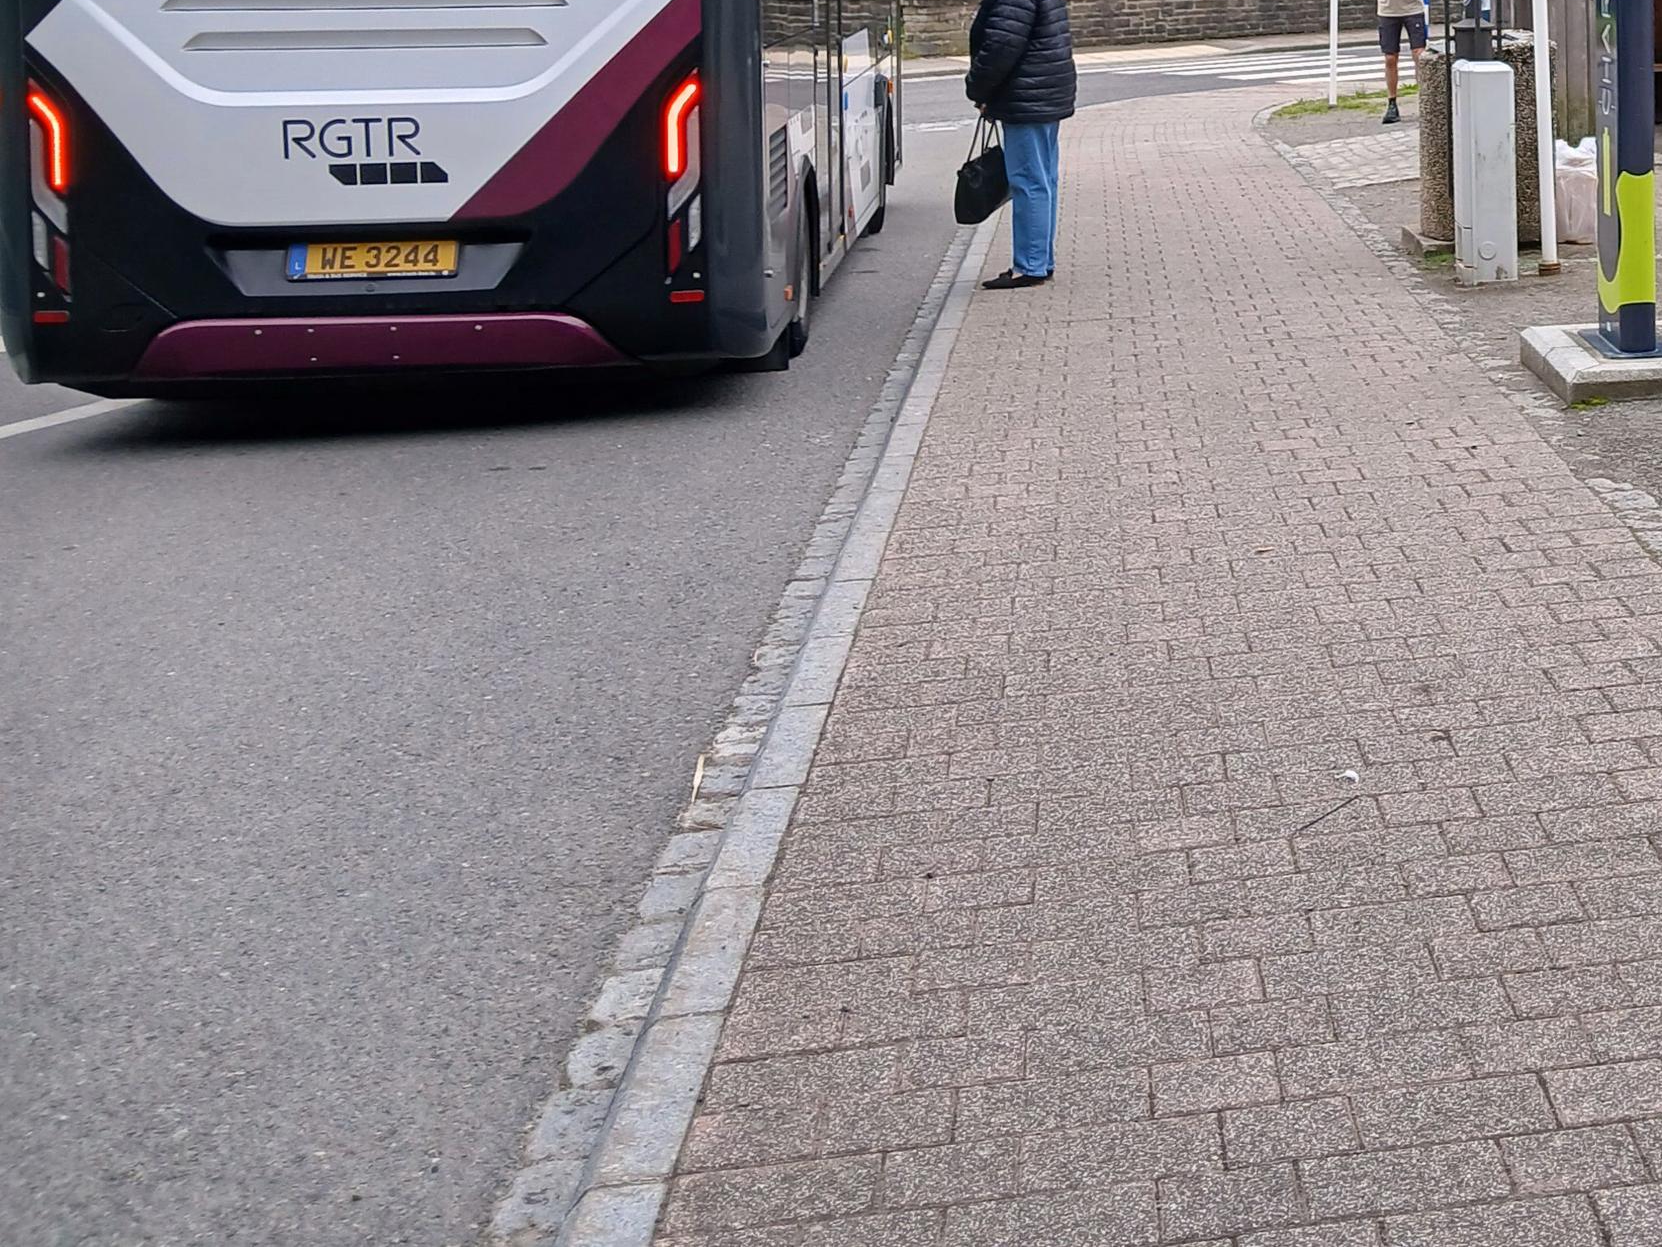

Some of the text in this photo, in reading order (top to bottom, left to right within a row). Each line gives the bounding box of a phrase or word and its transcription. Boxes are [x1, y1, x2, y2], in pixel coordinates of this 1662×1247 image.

[283, 117, 421, 159] RGTR
[294, 261, 302, 271] L
[321, 244, 440, 269] WE 3244
